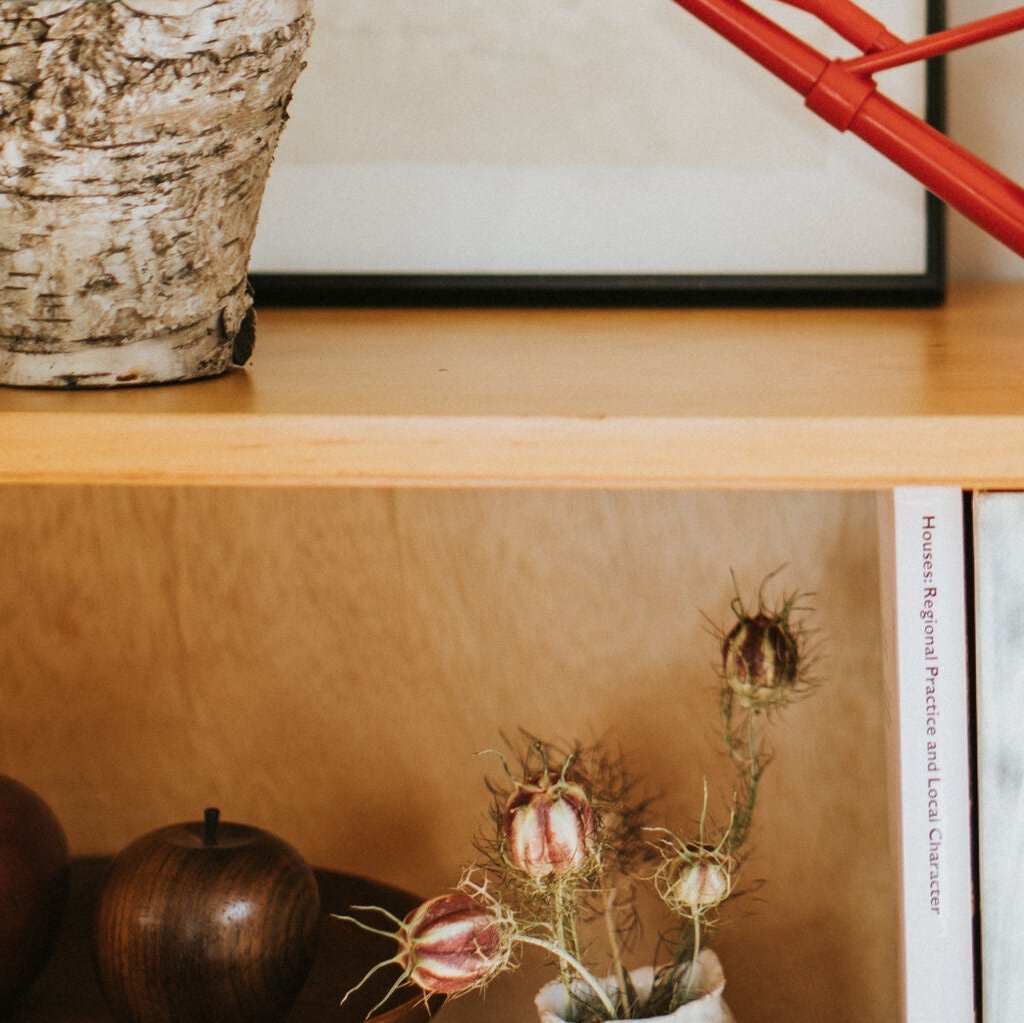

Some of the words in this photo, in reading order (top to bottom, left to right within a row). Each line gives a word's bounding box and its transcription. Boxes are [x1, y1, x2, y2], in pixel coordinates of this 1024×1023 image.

[922, 515, 936, 584] Houses:
[919, 586, 939, 661] Regional
[925, 666, 940, 737] Practice
[927, 740, 940, 772] and
[927, 776, 942, 823] Local
[929, 828, 943, 916] Character
